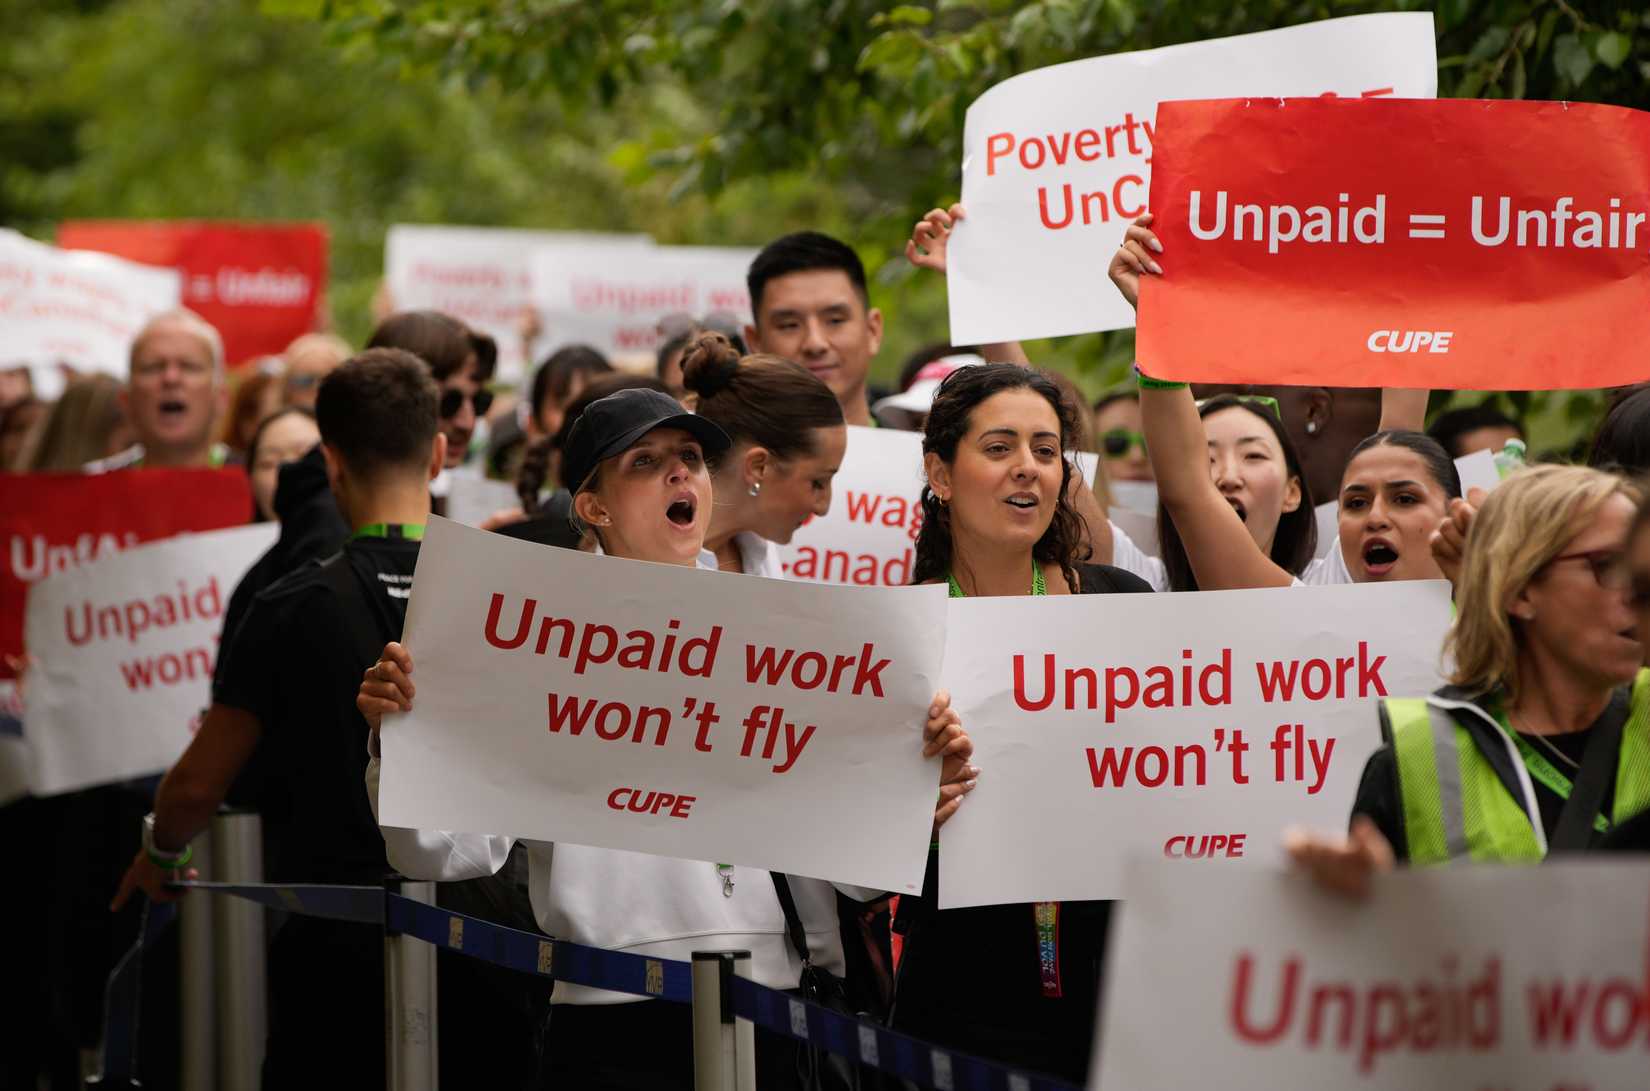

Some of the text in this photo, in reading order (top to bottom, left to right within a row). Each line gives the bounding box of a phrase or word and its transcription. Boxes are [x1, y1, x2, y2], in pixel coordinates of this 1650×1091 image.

[1037, 174, 1147, 231] UnC
[1189, 190, 1646, 254] Unpaid = Unfair
[1367, 329, 1454, 354] CUPE
[782, 545, 913, 587] anad
[64, 575, 223, 646] Unpaid
[484, 592, 892, 699] Unpaid work
[1012, 640, 1389, 724] Unpaid work
[547, 692, 817, 774] won't fly
[1085, 723, 1337, 796] won't fly
[607, 786, 698, 819] CUPE
[1163, 832, 1249, 860] CUPE
[1228, 951, 1650, 1075] Unpaid wo
